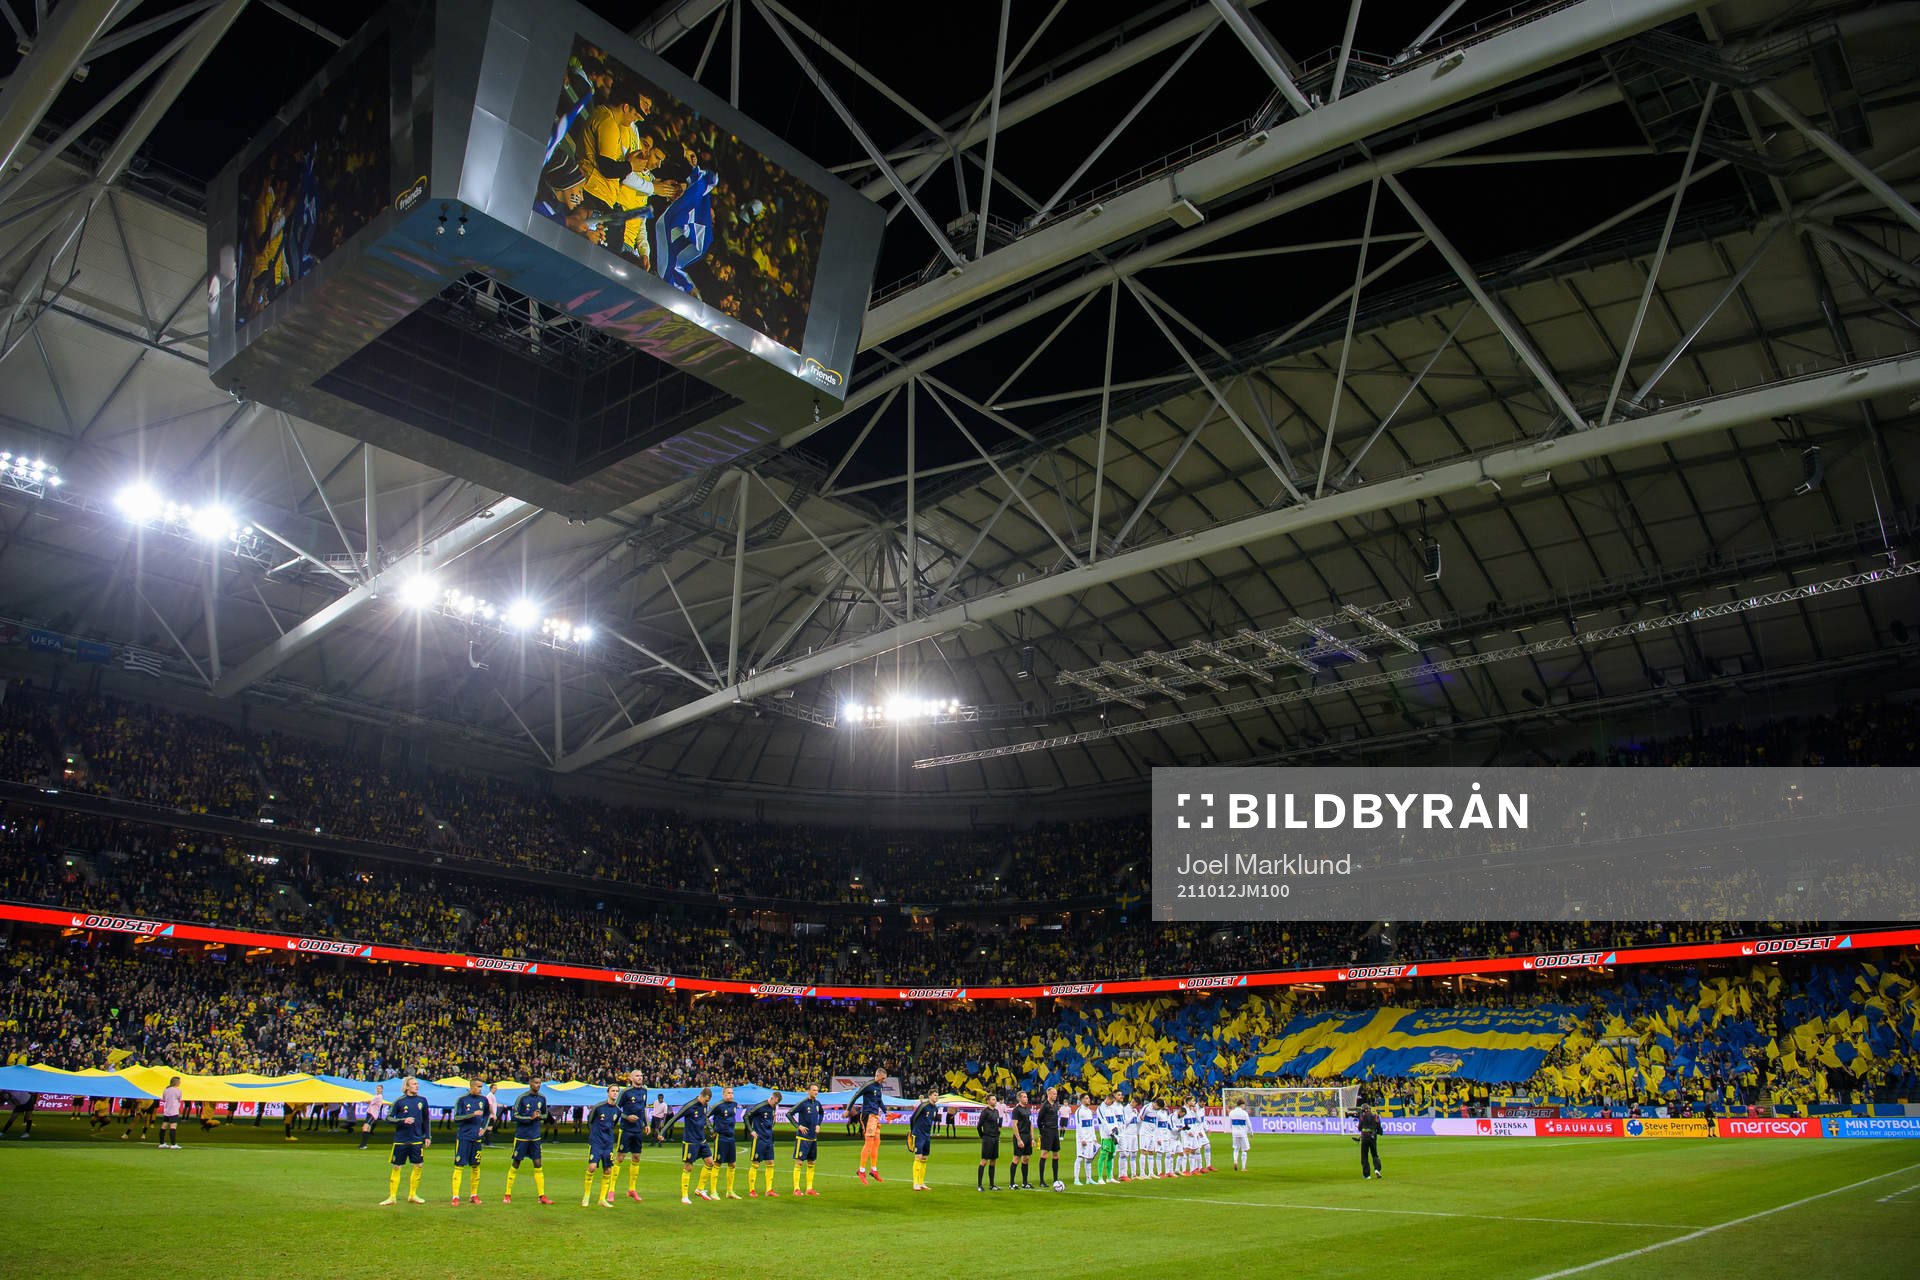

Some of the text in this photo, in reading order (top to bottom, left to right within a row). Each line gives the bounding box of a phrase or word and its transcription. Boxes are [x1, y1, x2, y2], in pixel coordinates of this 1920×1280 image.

[810, 364, 837, 385] friends
[31, 634, 61, 649] UEFA
[84, 914, 162, 934] ODDSET
[298, 938, 361, 955] ODDSET
[1755, 936, 1836, 954] ODDSET
[475, 958, 528, 972] ODDSET
[1534, 952, 1603, 969] ODDSET
[1347, 965, 1406, 979] ODDSET
[623, 972, 668, 986] ODDSET
[1187, 976, 1238, 989] ODDSET
[758, 984, 807, 995] ODDSET
[908, 988, 957, 999] ODDSET
[1050, 984, 1094, 996] ODDSET
[1262, 1118, 1323, 1131] Fotbollens
[1493, 1121, 1528, 1129] SVENSKA
[1555, 1123, 1613, 1133] BAUHAUS
[1644, 1122, 1708, 1131] Steve Perryma
[1730, 1121, 1808, 1136] merresor
[1846, 1119, 1920, 1129] MIN FOTBOLL
[1883, 1130, 1906, 1138] appen
